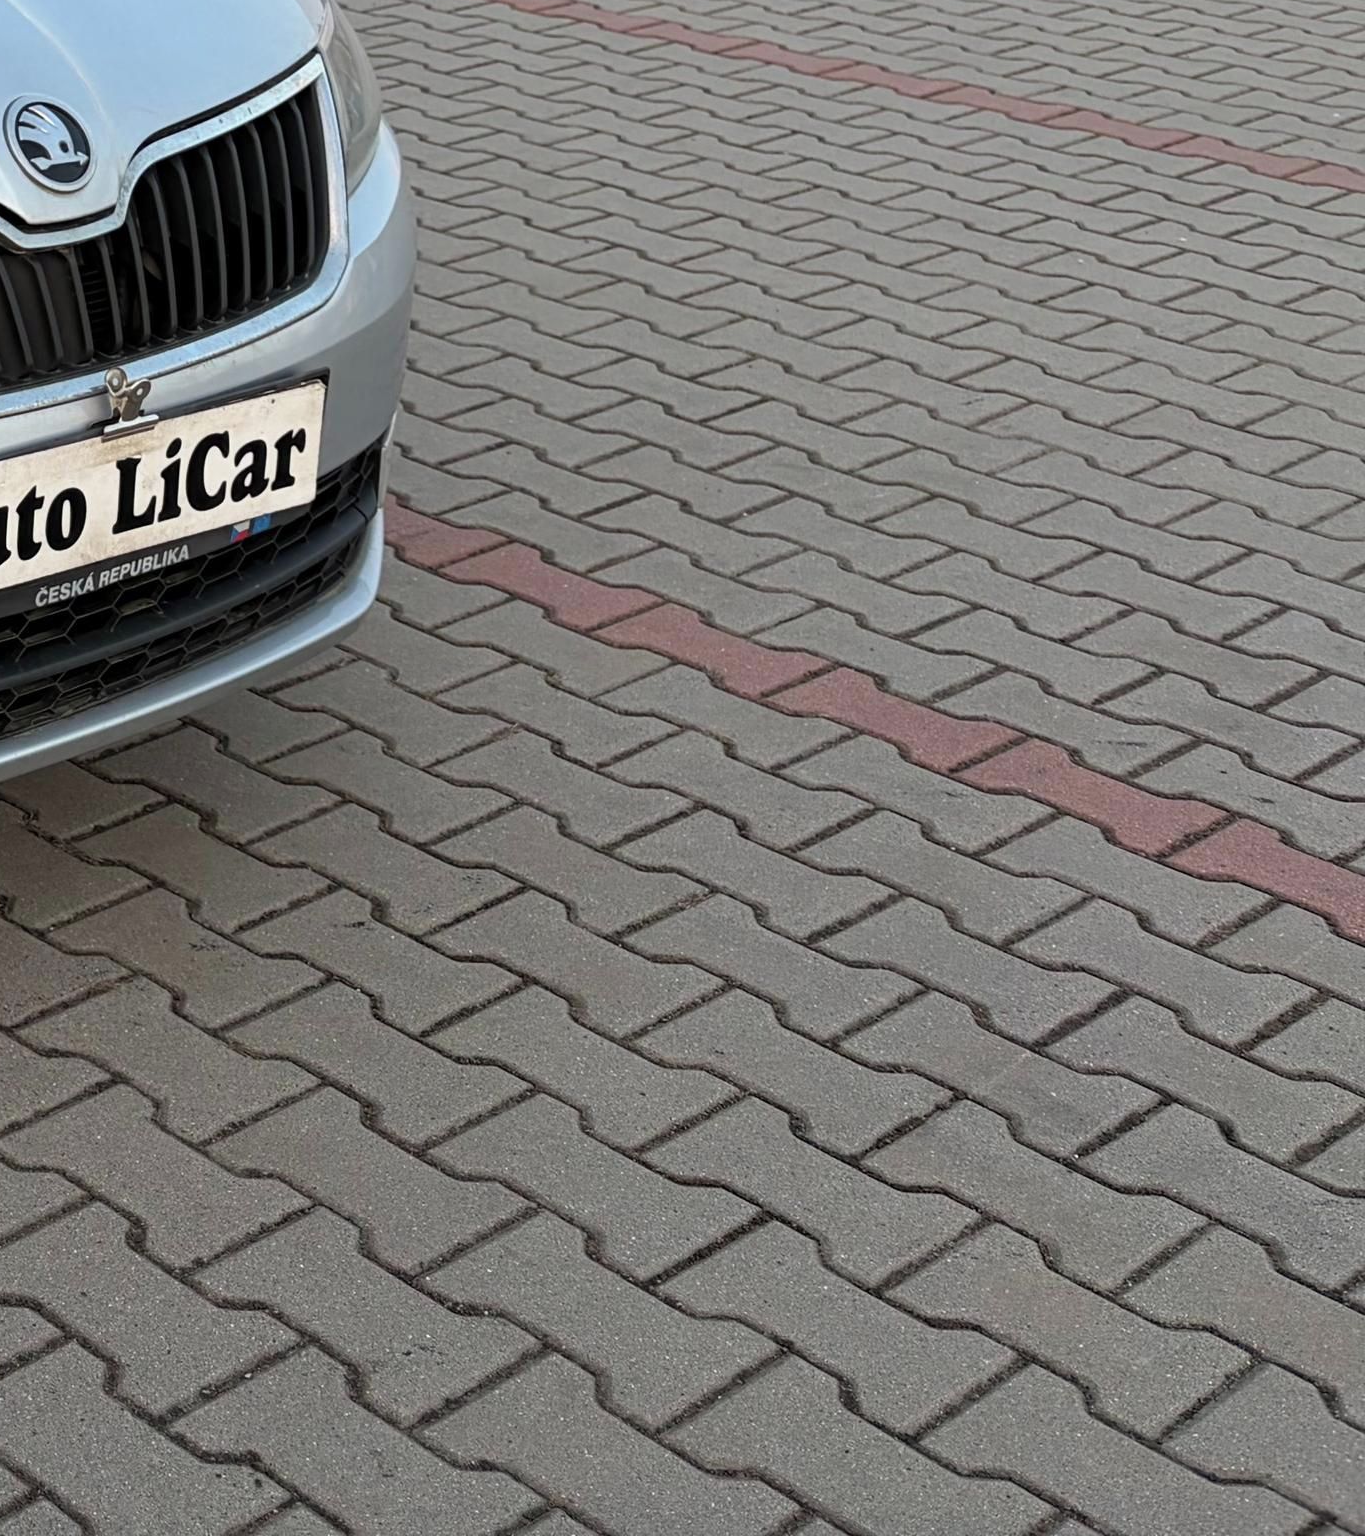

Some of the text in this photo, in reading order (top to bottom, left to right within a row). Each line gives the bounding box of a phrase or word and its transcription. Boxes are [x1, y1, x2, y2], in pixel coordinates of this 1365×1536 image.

[112, 428, 306, 535] LiCar
[35, 543, 190, 607] ČESKÁ REPUBLIKA
